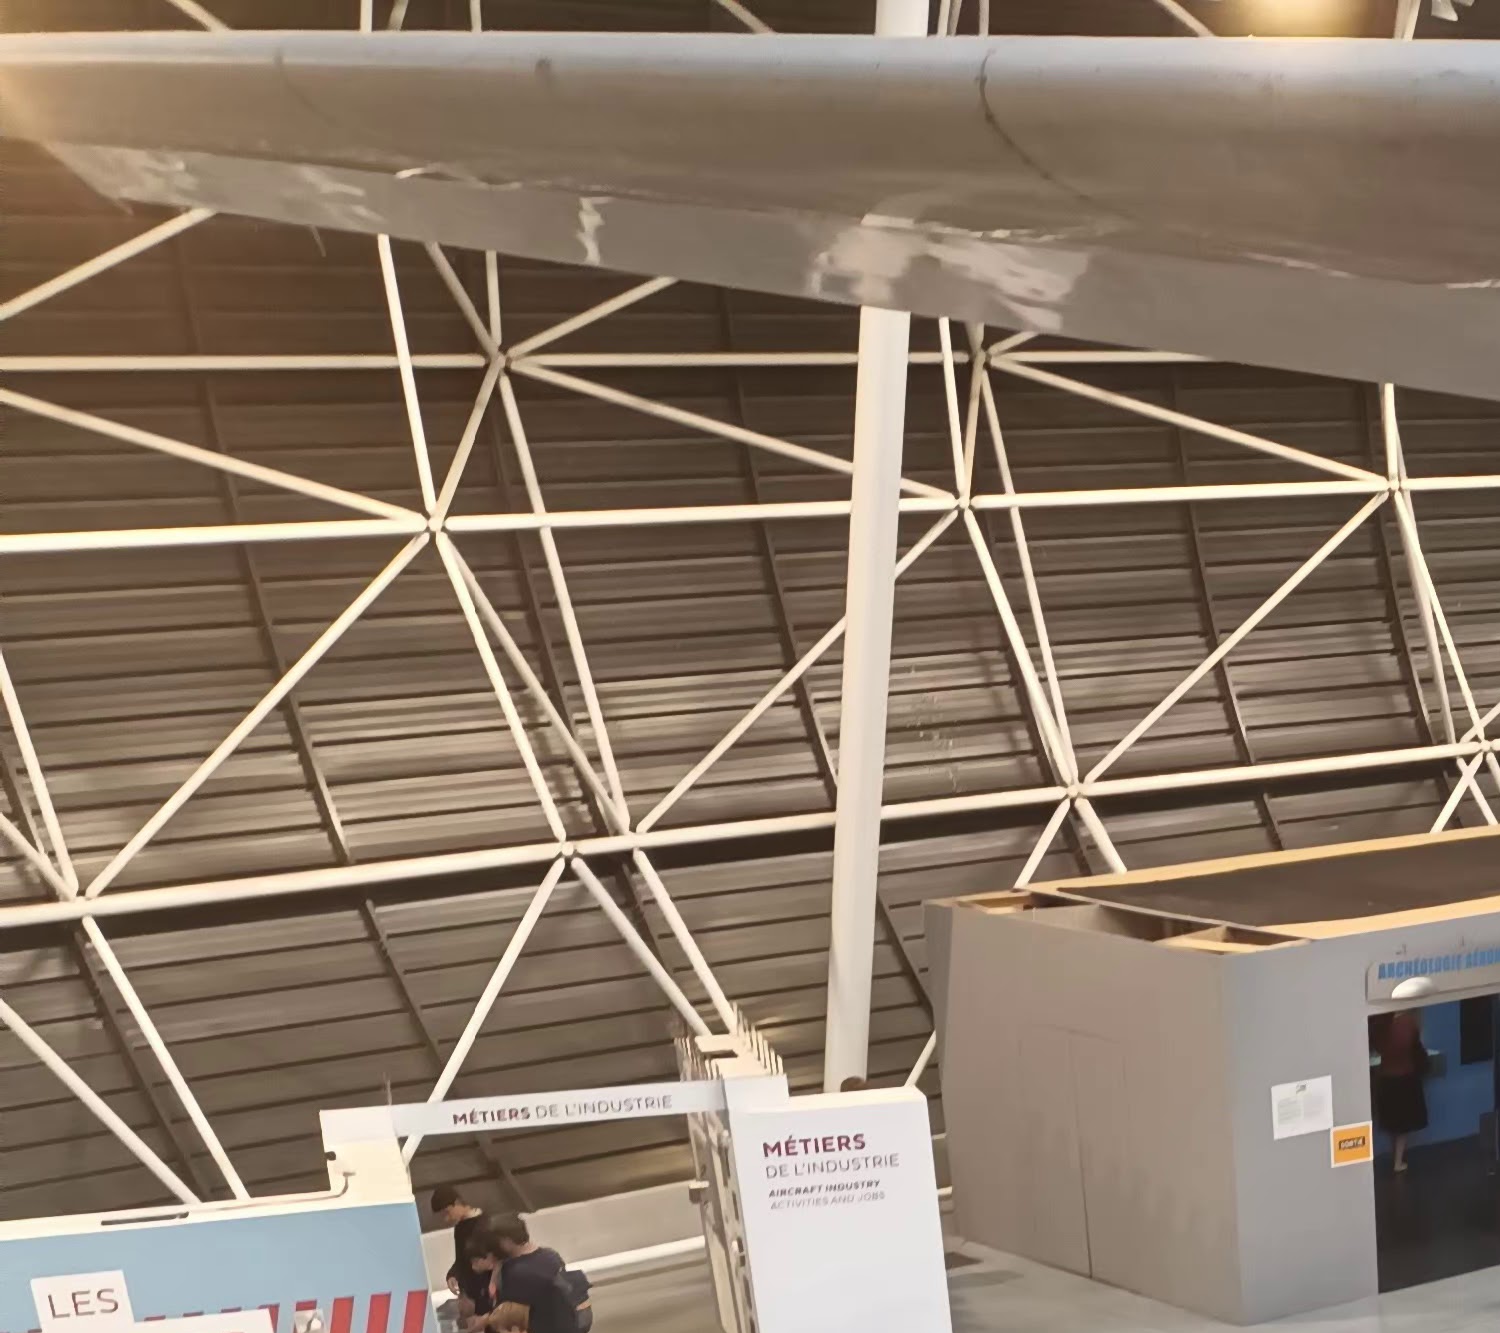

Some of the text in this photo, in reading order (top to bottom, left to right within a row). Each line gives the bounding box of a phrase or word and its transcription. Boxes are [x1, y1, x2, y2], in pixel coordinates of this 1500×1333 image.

[453, 1095, 672, 1125] MÉTIERS DE L'INDUSTRIE
[763, 1133, 866, 1158] MÉTIERS
[766, 1153, 900, 1179] DE L'INDUSTRIE
[769, 1179, 880, 1198] AIRCRAFT INDUSTRY
[771, 1191, 885, 1210] ACTIVITIES AND JOBS
[48, 1288, 119, 1319] LES
